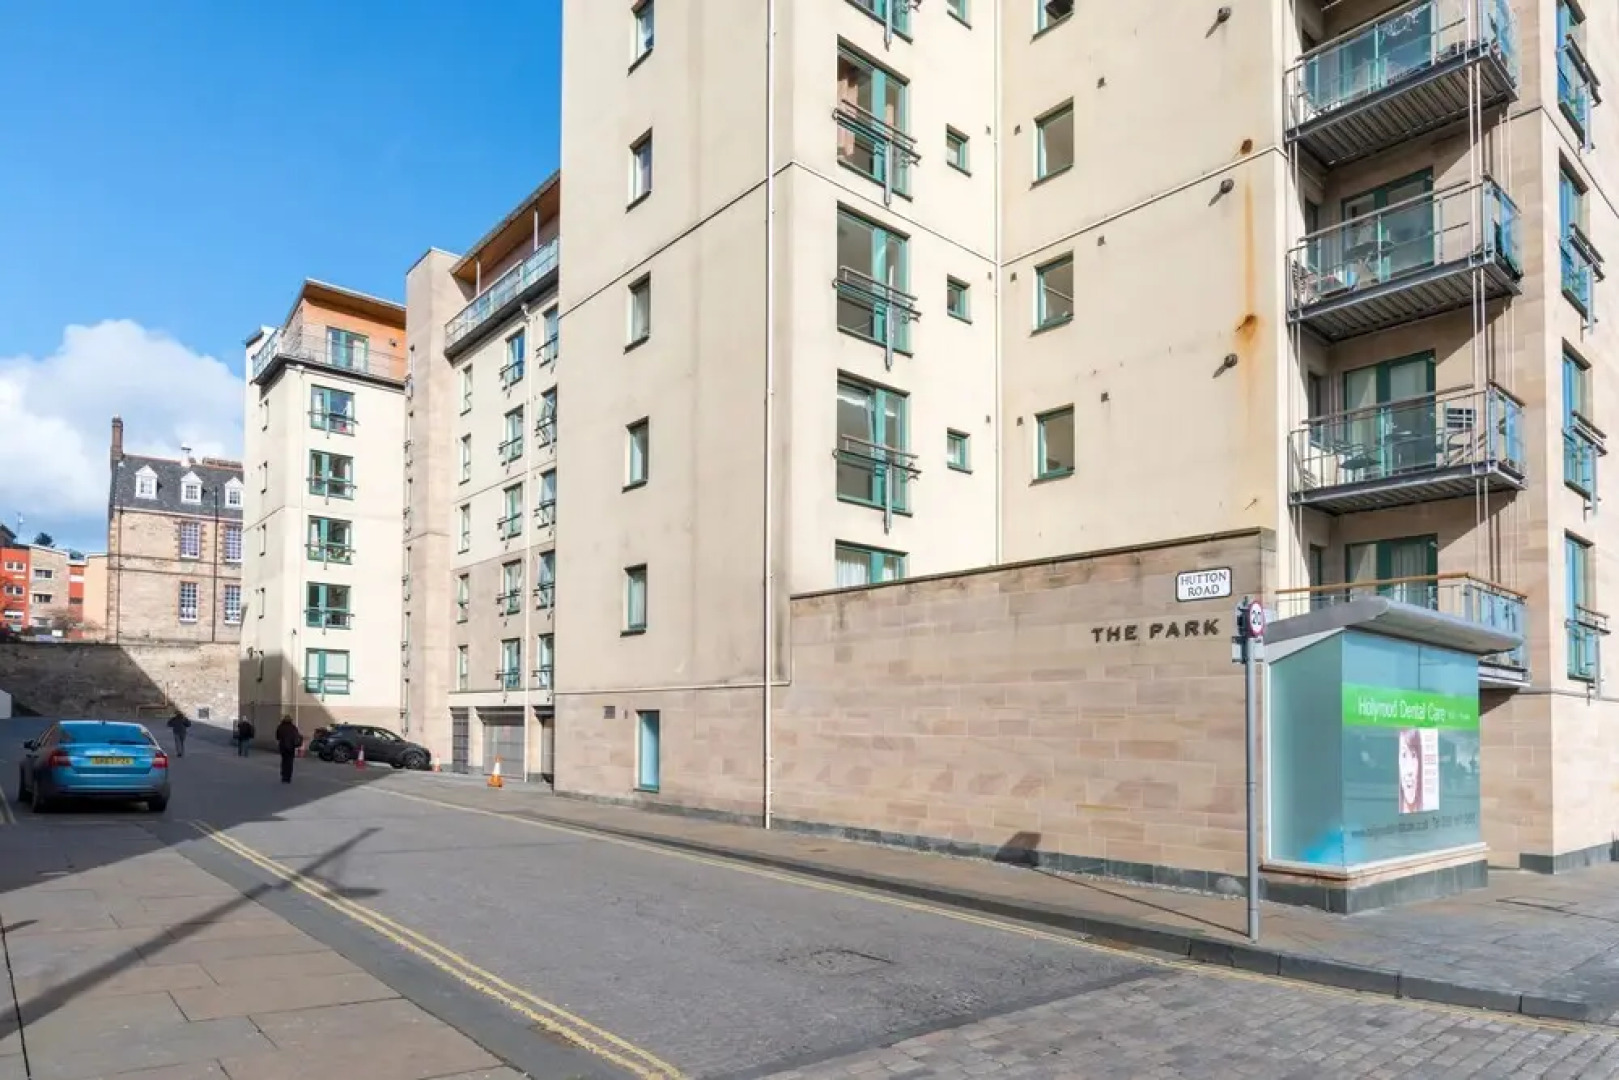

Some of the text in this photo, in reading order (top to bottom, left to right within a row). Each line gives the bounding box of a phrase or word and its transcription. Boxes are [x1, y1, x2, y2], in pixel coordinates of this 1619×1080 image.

[1180, 571, 1227, 586] HUTTON
[1187, 584, 1220, 597] ROAD
[1091, 619, 1220, 643] THE PARK
[1358, 697, 1397, 722] Holyrood
[1399, 700, 1426, 719] Dental
[1428, 702, 1446, 720] Care
